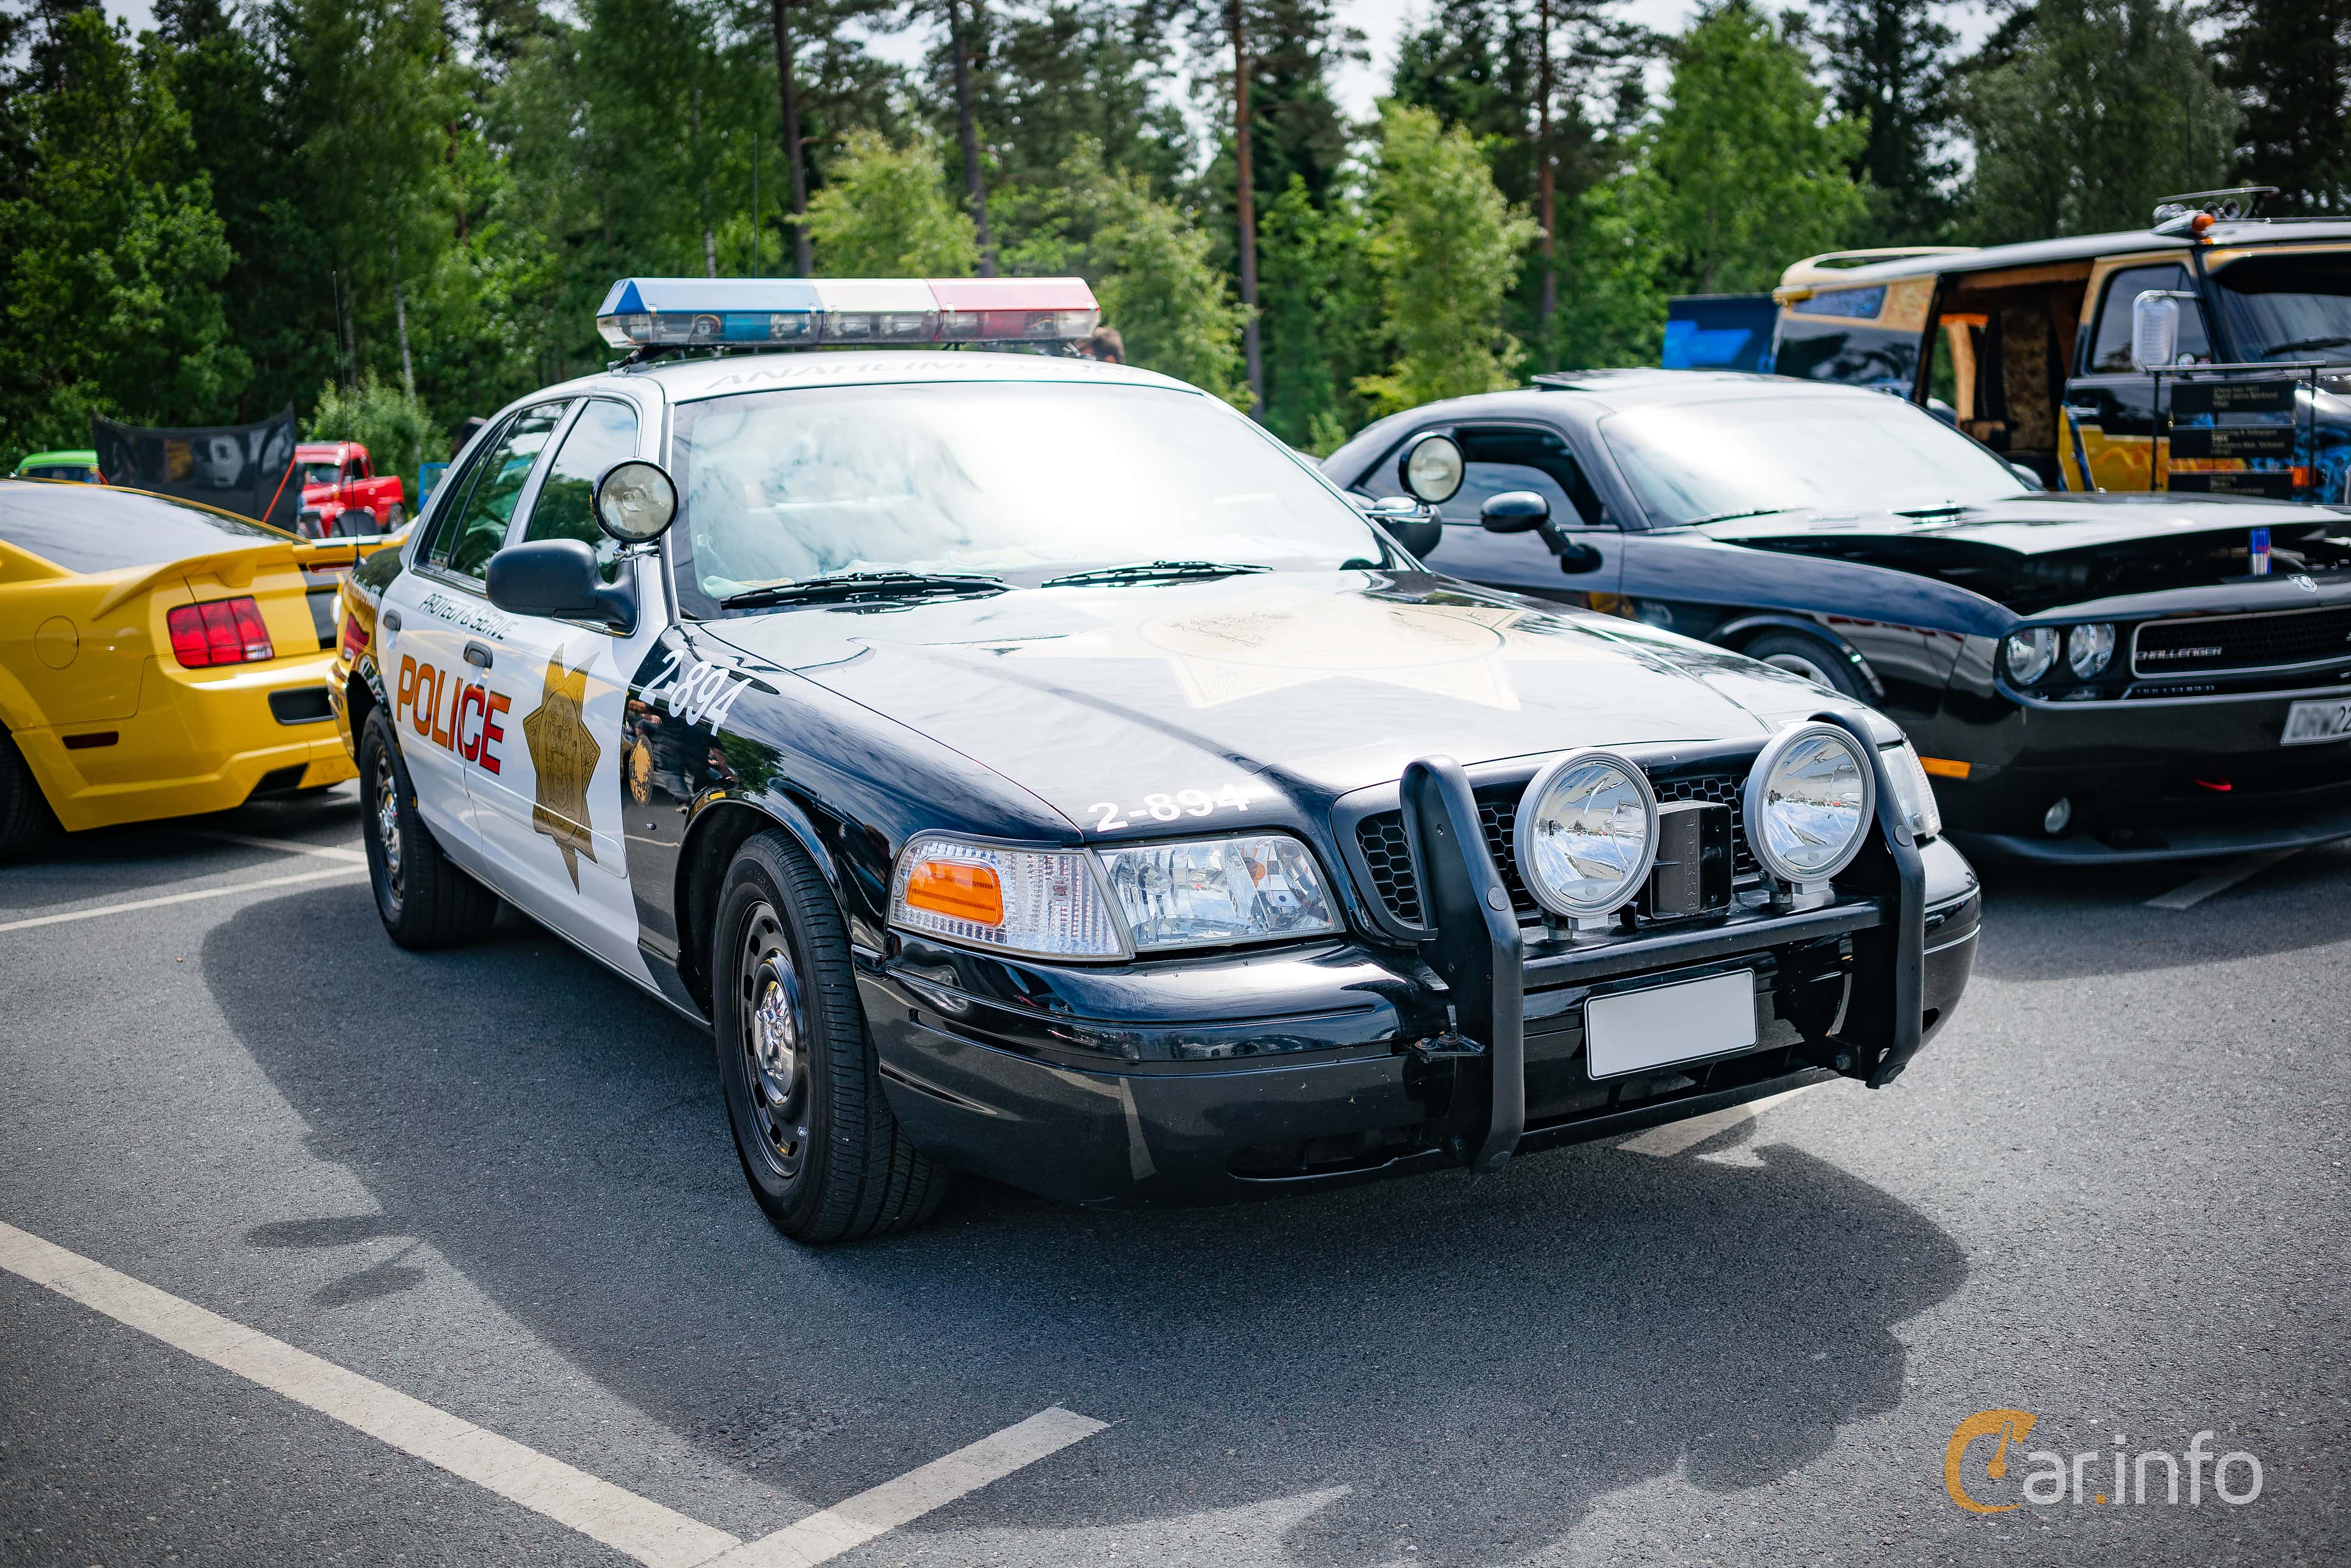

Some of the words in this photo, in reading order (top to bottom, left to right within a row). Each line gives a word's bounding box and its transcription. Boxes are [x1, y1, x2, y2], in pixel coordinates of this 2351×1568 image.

[418, 593, 471, 621] PROTECT
[470, 606, 519, 640] SERVE
[397, 653, 512, 776] POLICE
[639, 649, 753, 737] 2-894
[1088, 783, 1250, 832] 2-894
